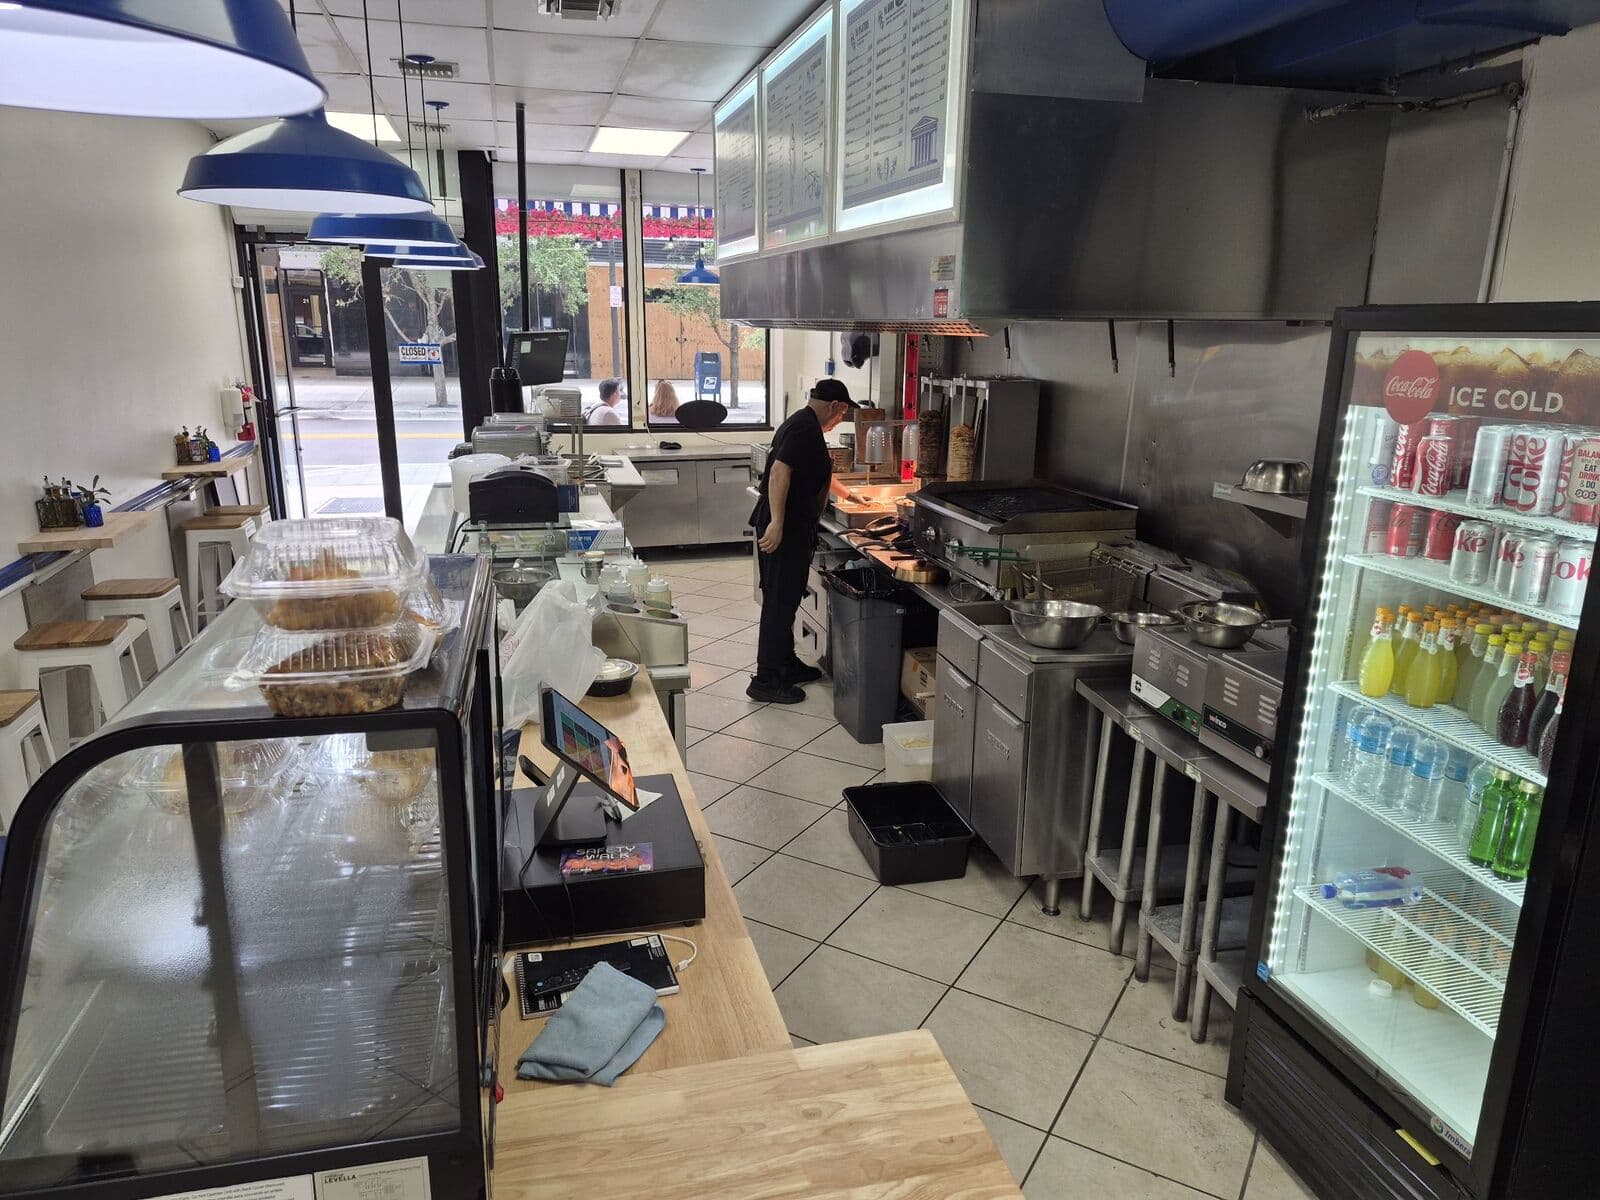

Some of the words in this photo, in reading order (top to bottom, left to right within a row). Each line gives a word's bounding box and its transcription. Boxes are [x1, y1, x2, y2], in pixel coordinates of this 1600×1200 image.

[401, 347, 426, 356] CLOSED
[1449, 386, 1487, 408] ICE
[1494, 388, 1564, 414] COLD
[1208, 713, 1228, 729] winco
[576, 845, 635, 856] SAFETY
[585, 852, 630, 860] WALK
[324, 1174, 357, 1184] LEVELLA
